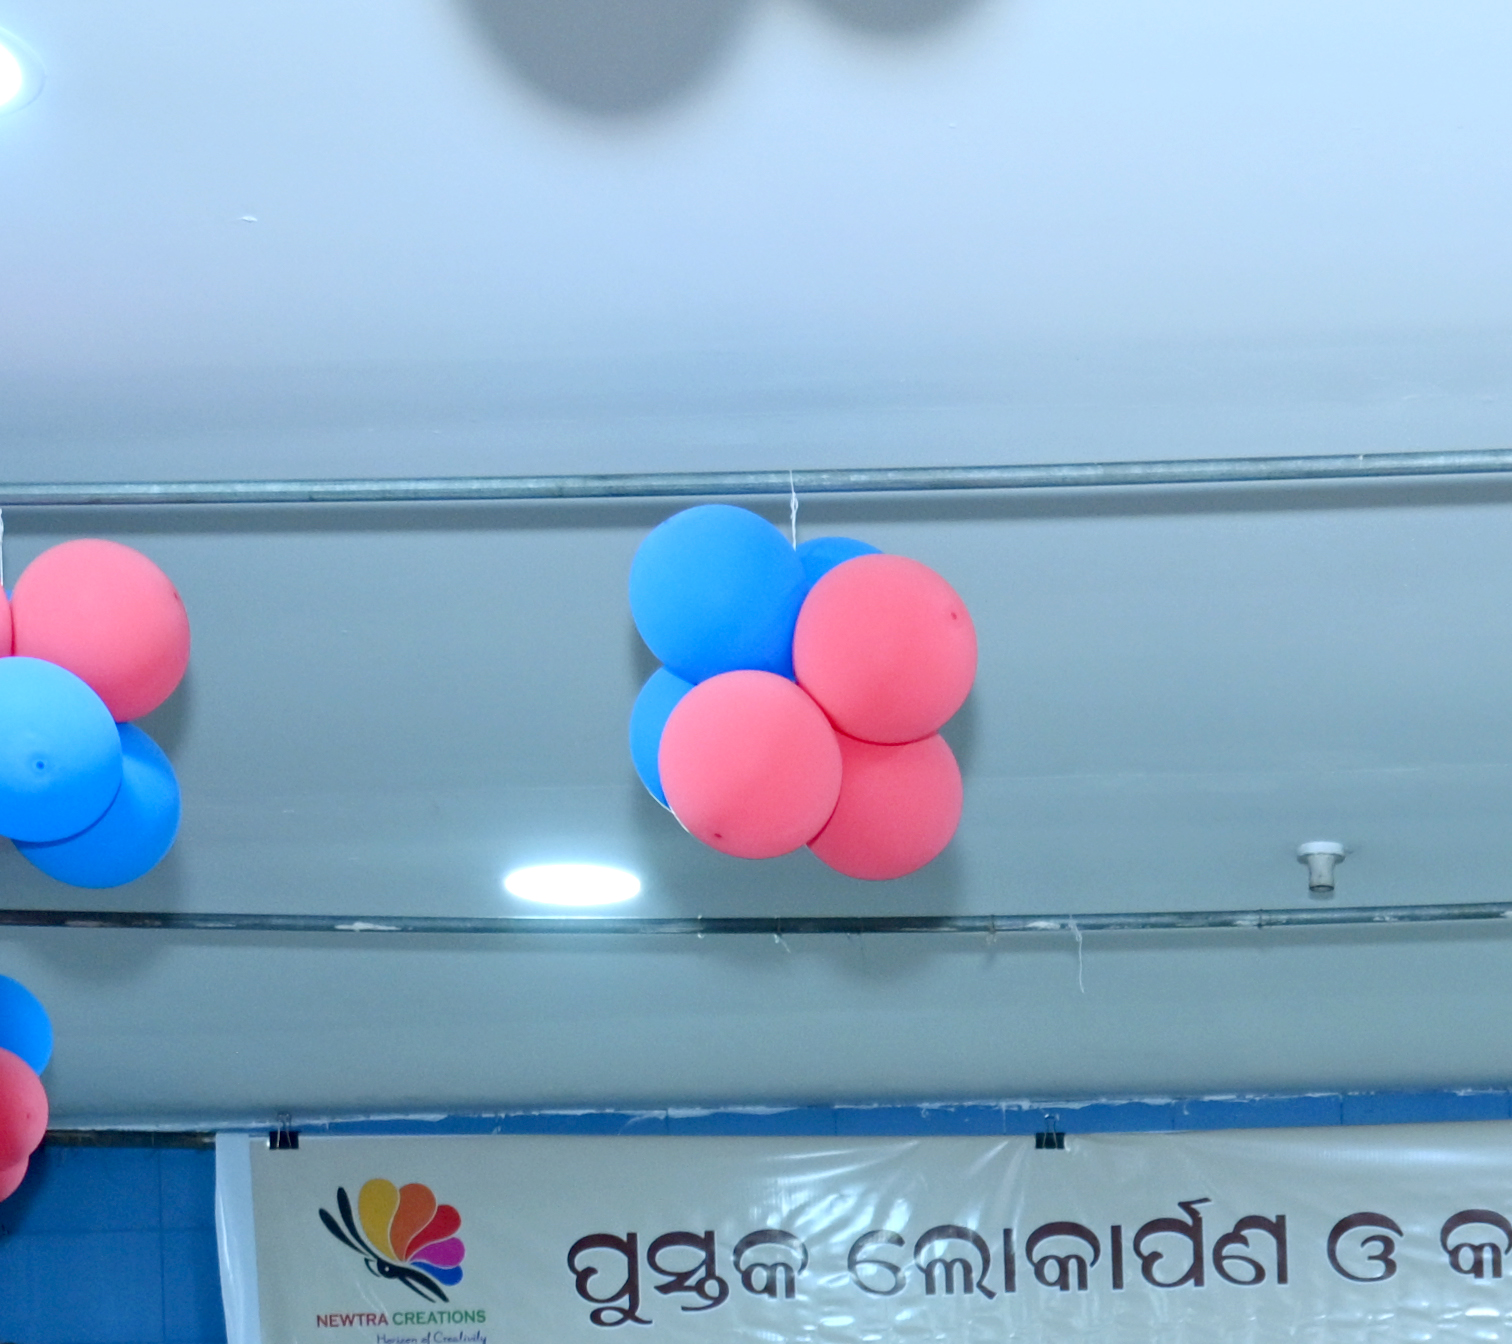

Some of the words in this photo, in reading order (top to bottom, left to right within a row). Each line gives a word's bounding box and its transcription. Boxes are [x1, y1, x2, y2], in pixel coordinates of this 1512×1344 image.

[567, 1226, 809, 1328] ପୁସ୍ତକ
[846, 1198, 1290, 1302] ଲୋକାର୍ପଣ
[1326, 1211, 1404, 1283] ଓ
[316, 1313, 389, 1328] NEWTRA
[392, 1309, 487, 1326] CREATIONS
